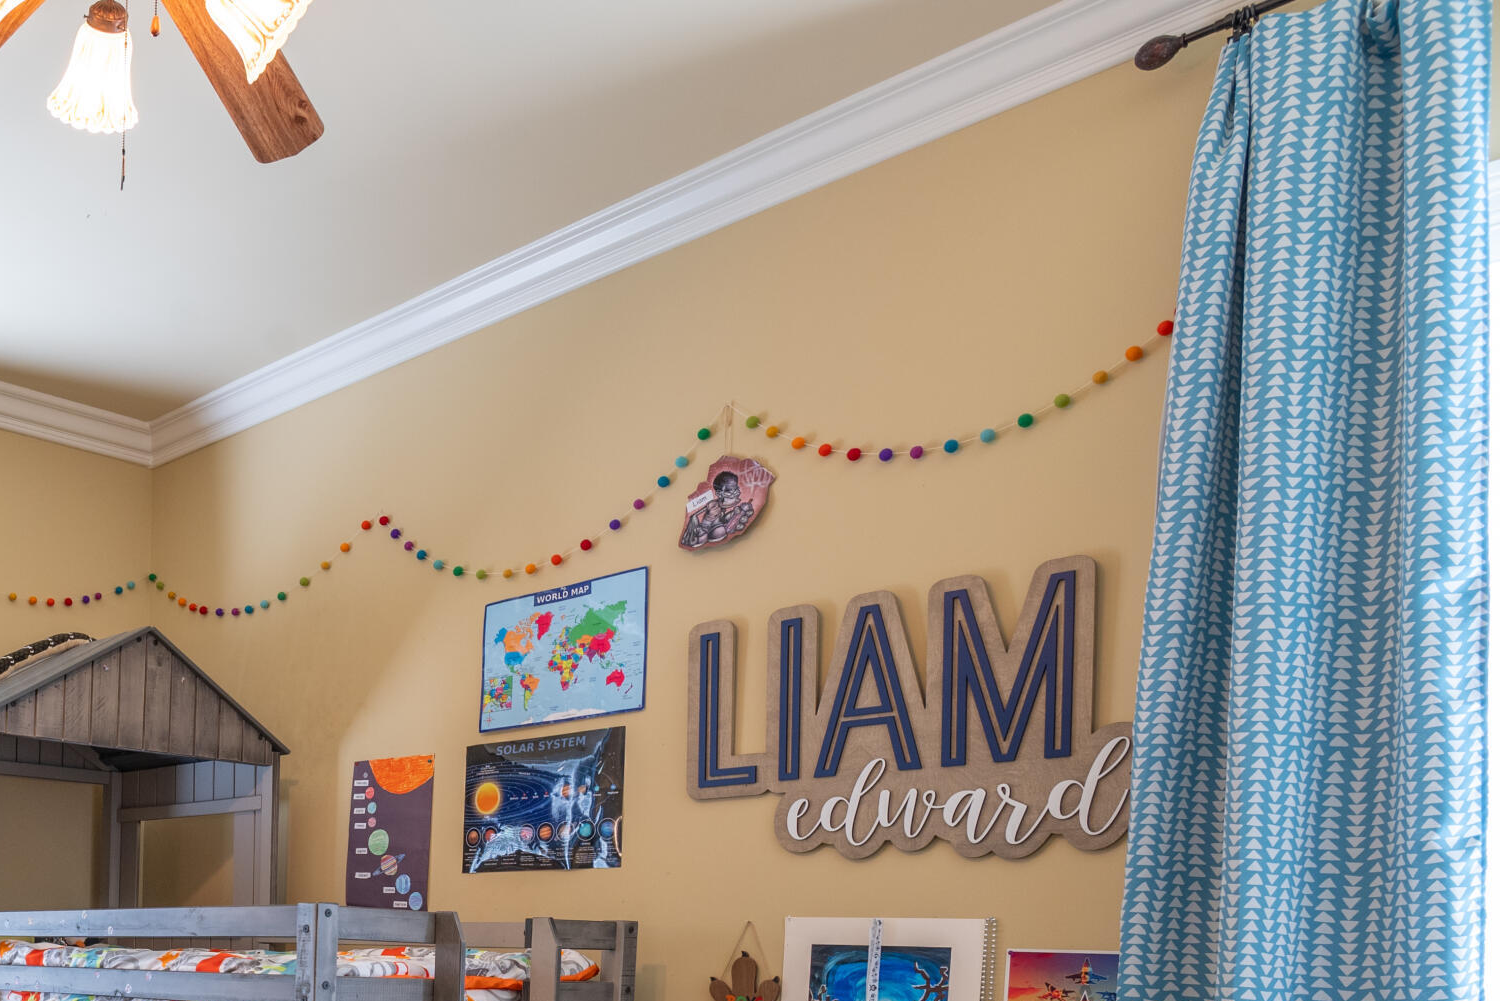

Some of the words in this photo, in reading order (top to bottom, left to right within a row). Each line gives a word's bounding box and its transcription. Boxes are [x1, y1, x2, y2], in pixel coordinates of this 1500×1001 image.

[536, 590, 569, 604] WORLD
[571, 585, 590, 596] MAP
[699, 570, 1077, 789] LIAM
[496, 742, 534, 756] SOLAR
[538, 736, 587, 750] SYSTEM
[786, 735, 1131, 847] edward
